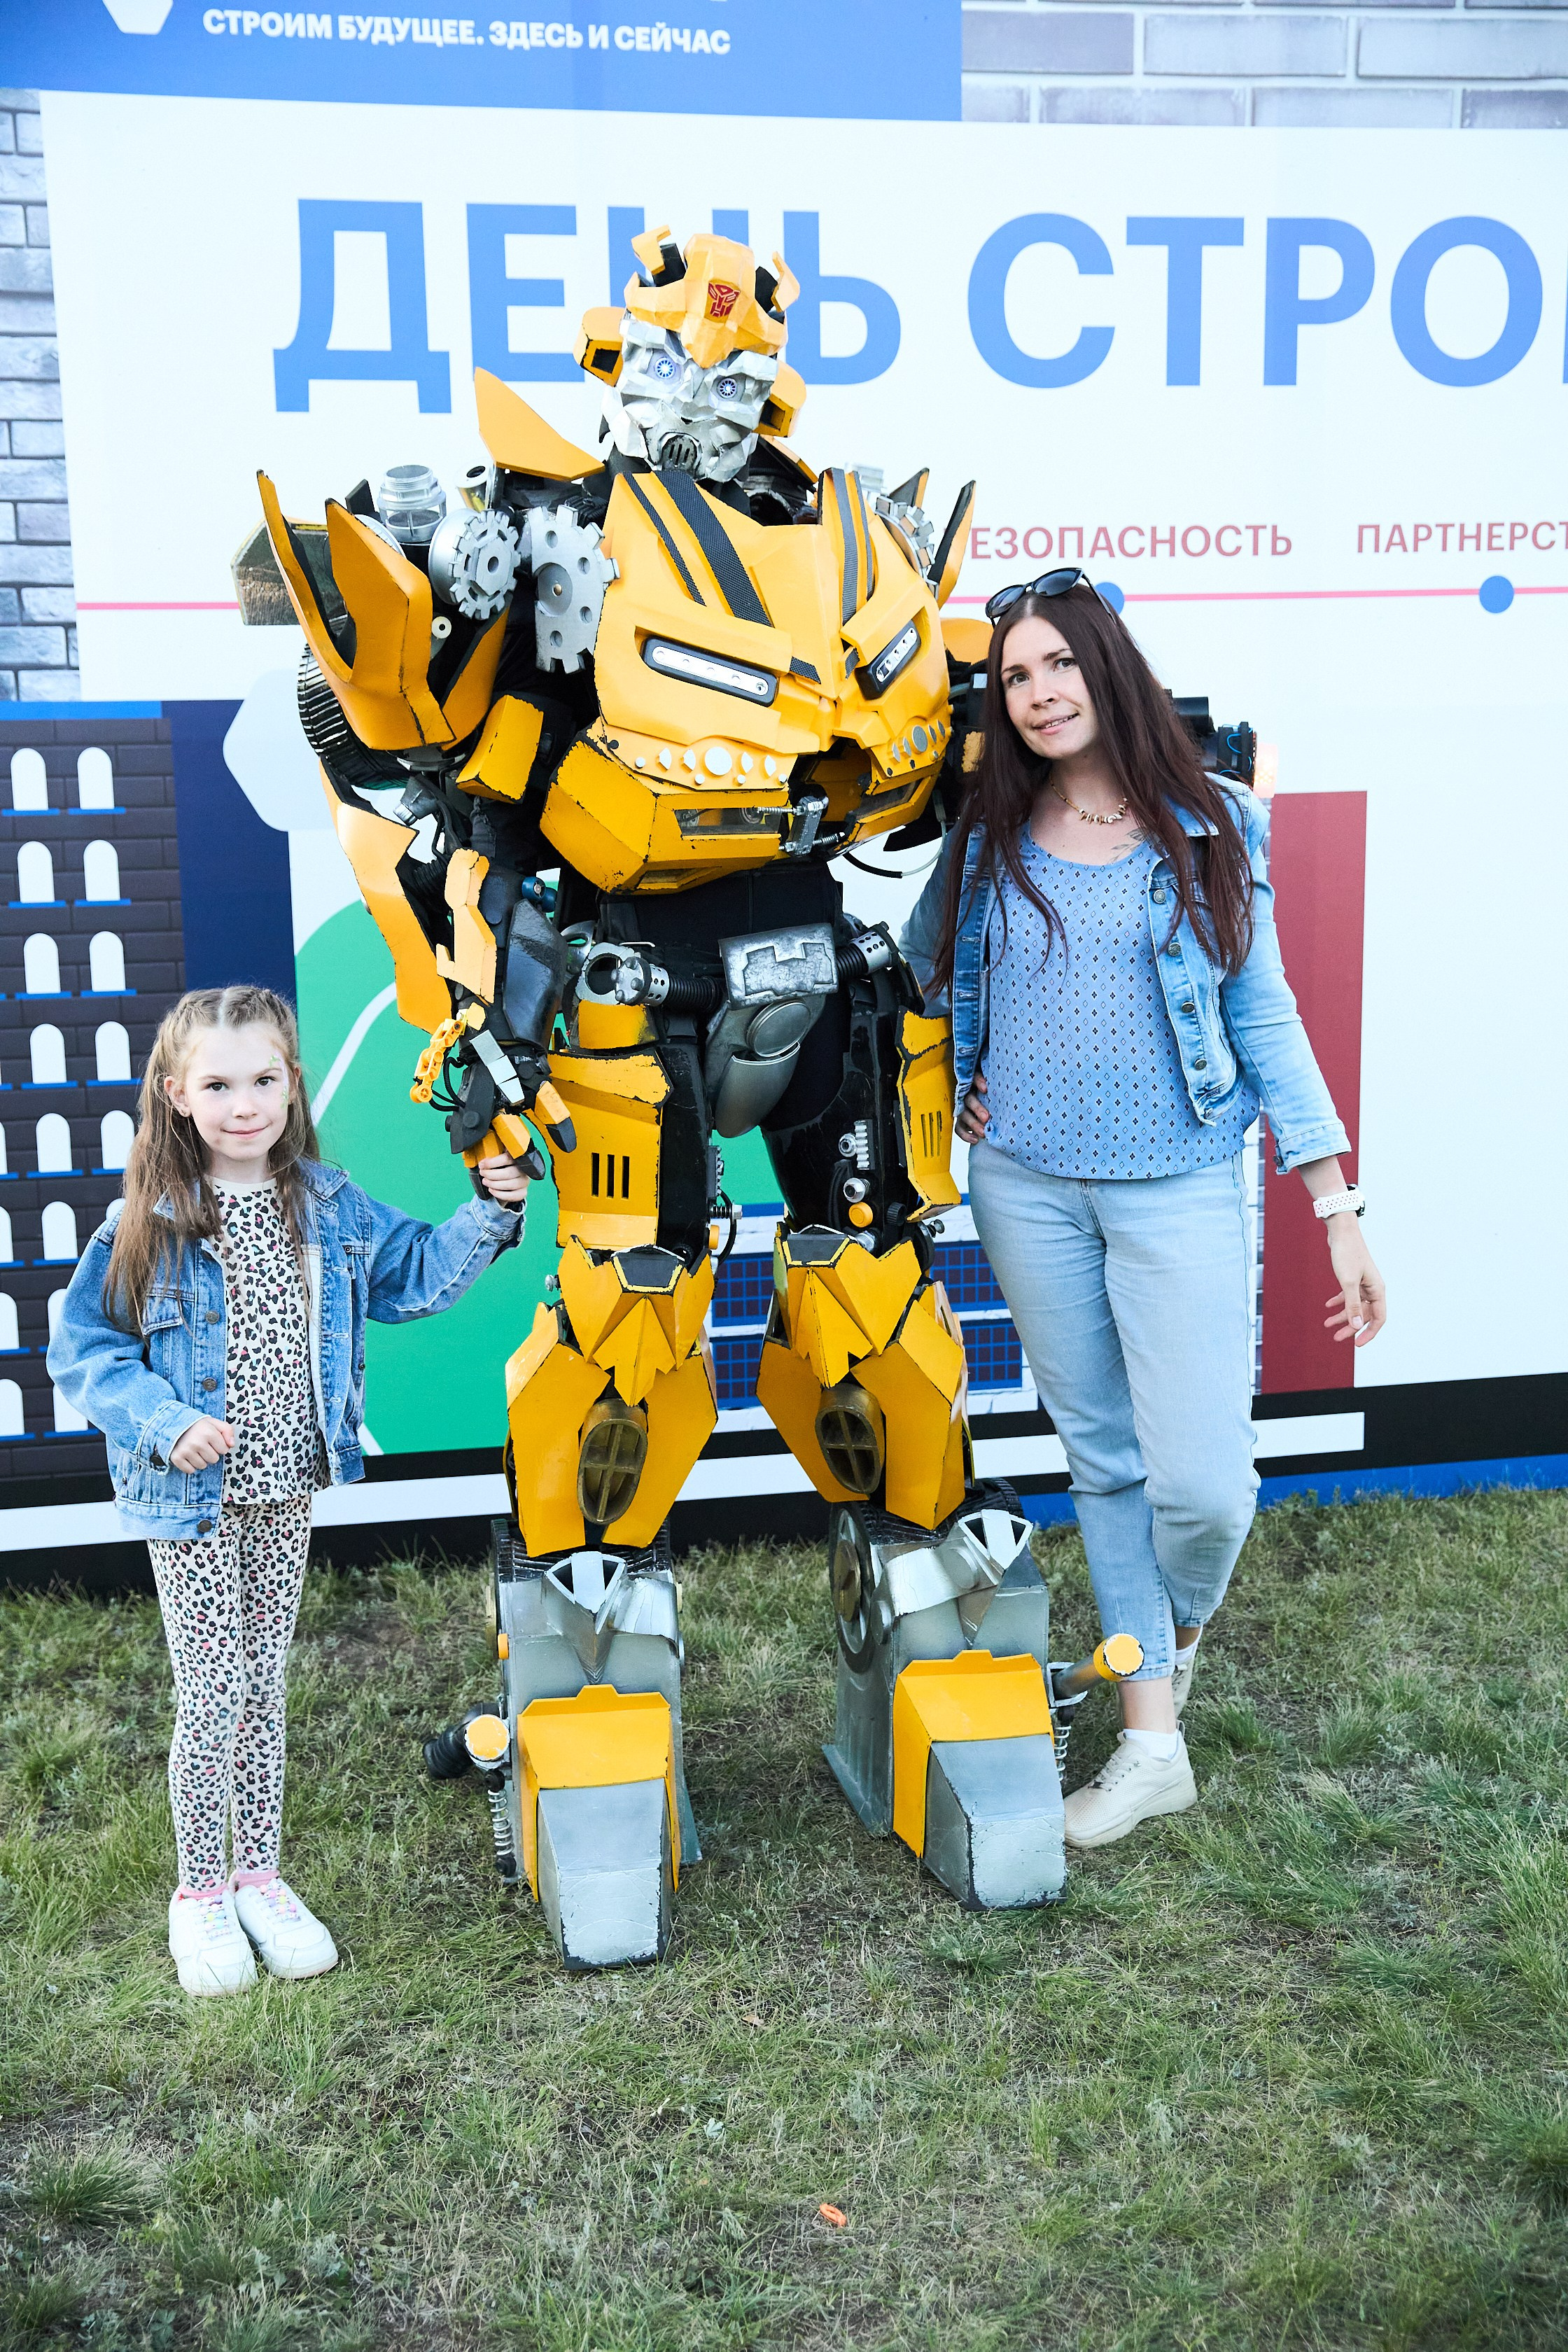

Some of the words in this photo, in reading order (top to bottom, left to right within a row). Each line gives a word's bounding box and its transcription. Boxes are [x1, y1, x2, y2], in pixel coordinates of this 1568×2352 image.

[204, 9, 332, 39] СТРОИМ
[338, 15, 484, 47] БУДУЩЕЕ.
[489, 21, 584, 50] ЗДЕСЬ
[588, 24, 609, 50] И
[614, 22, 731, 55] СЕЙЧАС
[967, 213, 1568, 388] СТРО
[944, 526, 1292, 559] ЕЗОПАСНОСТЬ
